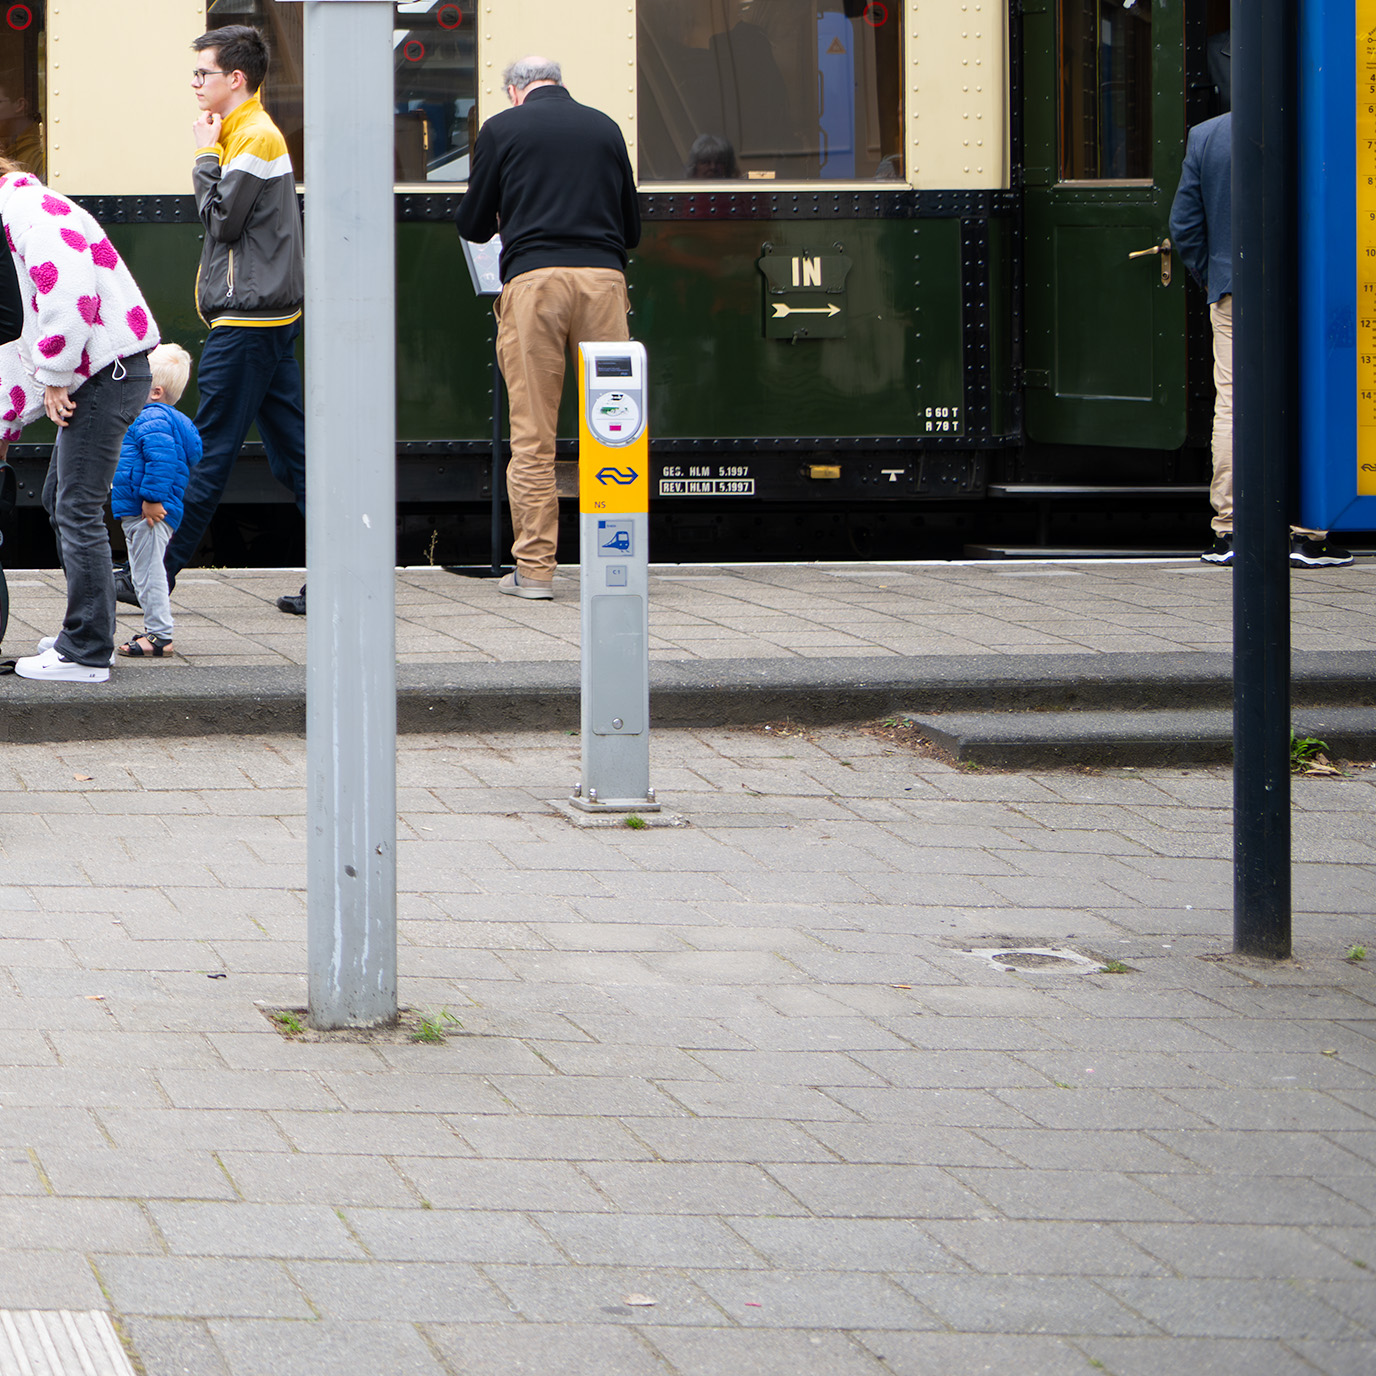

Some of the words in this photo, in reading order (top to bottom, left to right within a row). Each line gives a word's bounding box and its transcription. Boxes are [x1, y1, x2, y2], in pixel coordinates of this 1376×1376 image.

[791, 256, 822, 287] IN
[951, 407, 959, 418] T
[951, 420, 959, 432] T
[689, 466, 710, 477] HLM
[718, 466, 749, 477] 5.1997
[663, 482, 684, 493] REV.
[689, 482, 711, 493] HLM
[719, 482, 749, 493] 5.1997
[594, 501, 606, 509] NS
